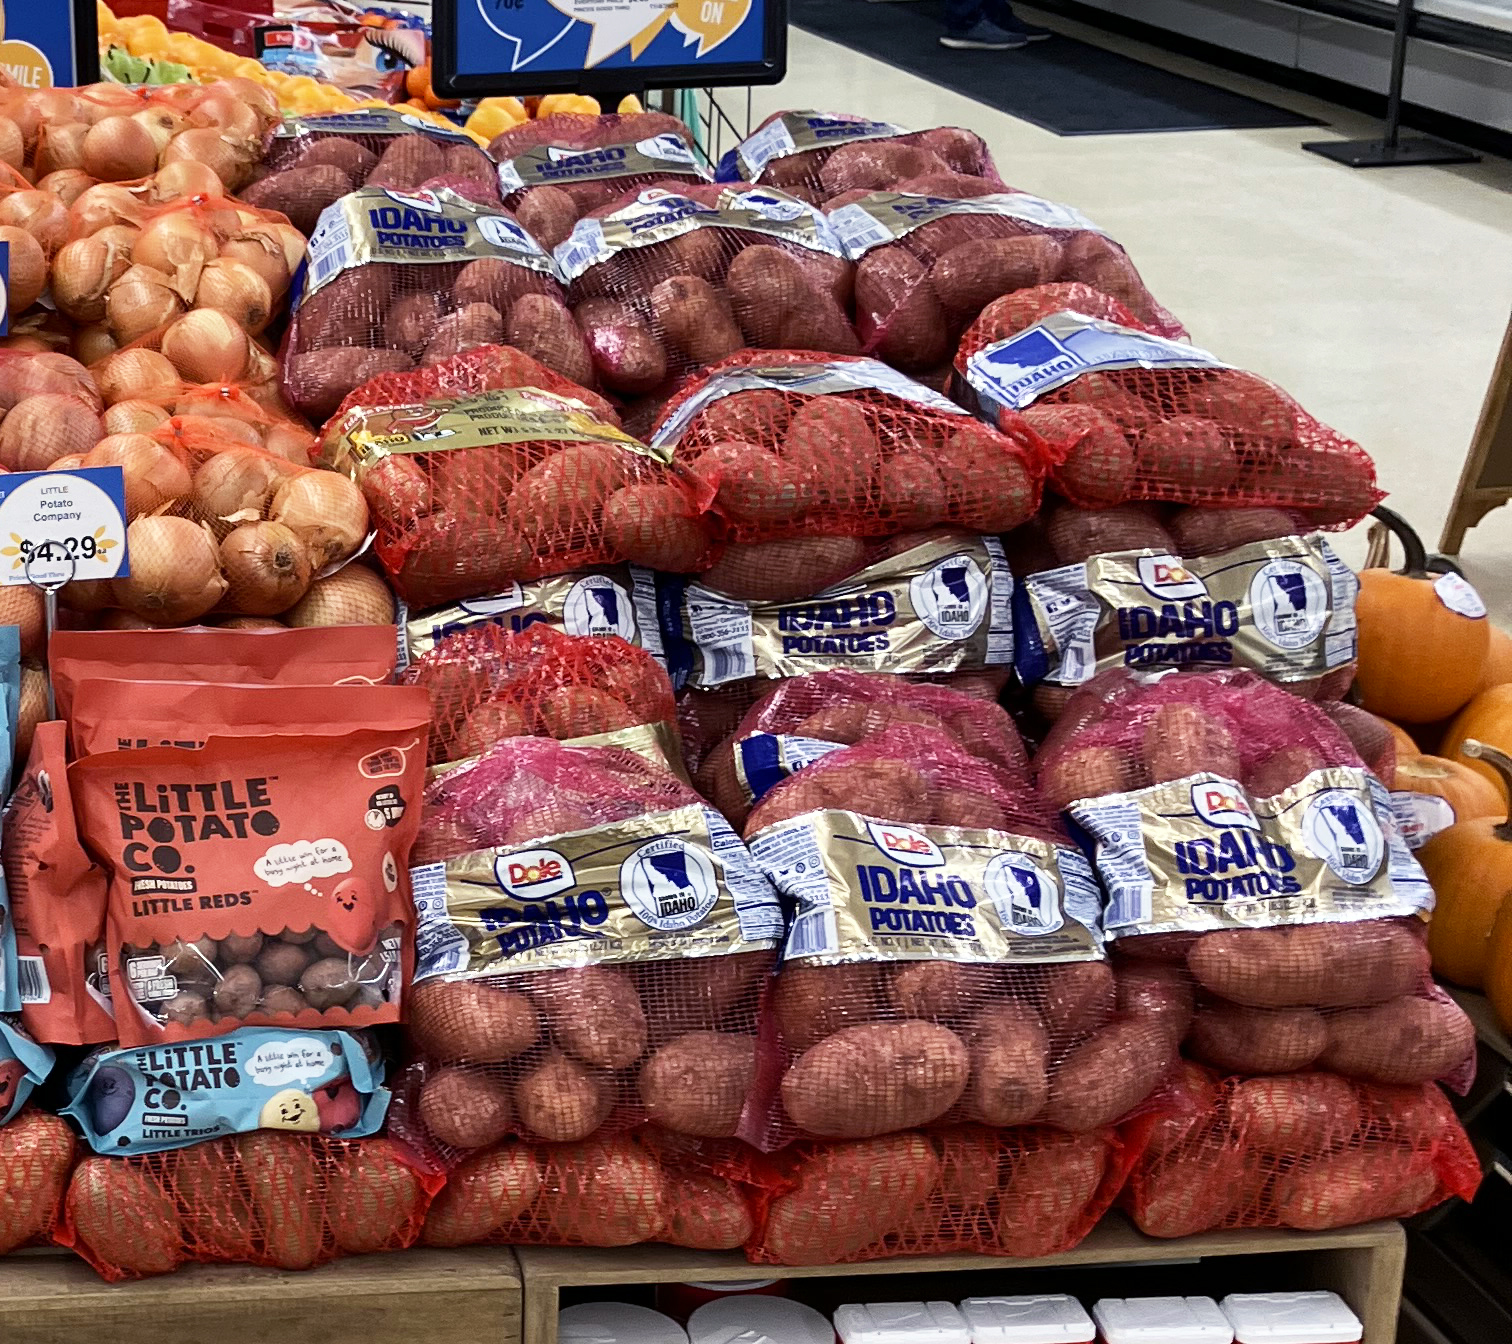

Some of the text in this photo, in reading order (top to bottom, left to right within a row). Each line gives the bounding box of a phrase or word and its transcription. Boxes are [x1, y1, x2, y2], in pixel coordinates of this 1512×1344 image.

[700, 0, 724, 26] ON
[368, 207, 468, 235] IDAHO
[377, 231, 466, 248] POTATOES
[40, 485, 69, 495] LITTLE
[40, 499, 73, 509] Potato
[33, 510, 81, 522] Company
[19, 535, 97, 563] $4.29
[778, 590, 896, 632] IDAHO
[941, 611, 969, 624] IDAHO
[1119, 600, 1238, 640] IDAHO
[782, 632, 890, 655] POTATOES
[113, 782, 132, 812] THE
[120, 809, 281, 844] POTATO
[881, 831, 934, 855] Dole
[1173, 828, 1297, 878] IDAHO
[122, 842, 196, 874] CO.
[507, 857, 563, 887] Dole
[855, 864, 978, 909] IDAHO
[131, 890, 253, 918] LITTLE REDS
[479, 889, 610, 933] IDAHO
[658, 897, 699, 918] IDAHO
[870, 907, 977, 937] POTATOES
[144, 1066, 241, 1092] POTATO
[144, 1087, 187, 1111] CO.
[142, 1124, 220, 1139] LITTLE TRIOS
